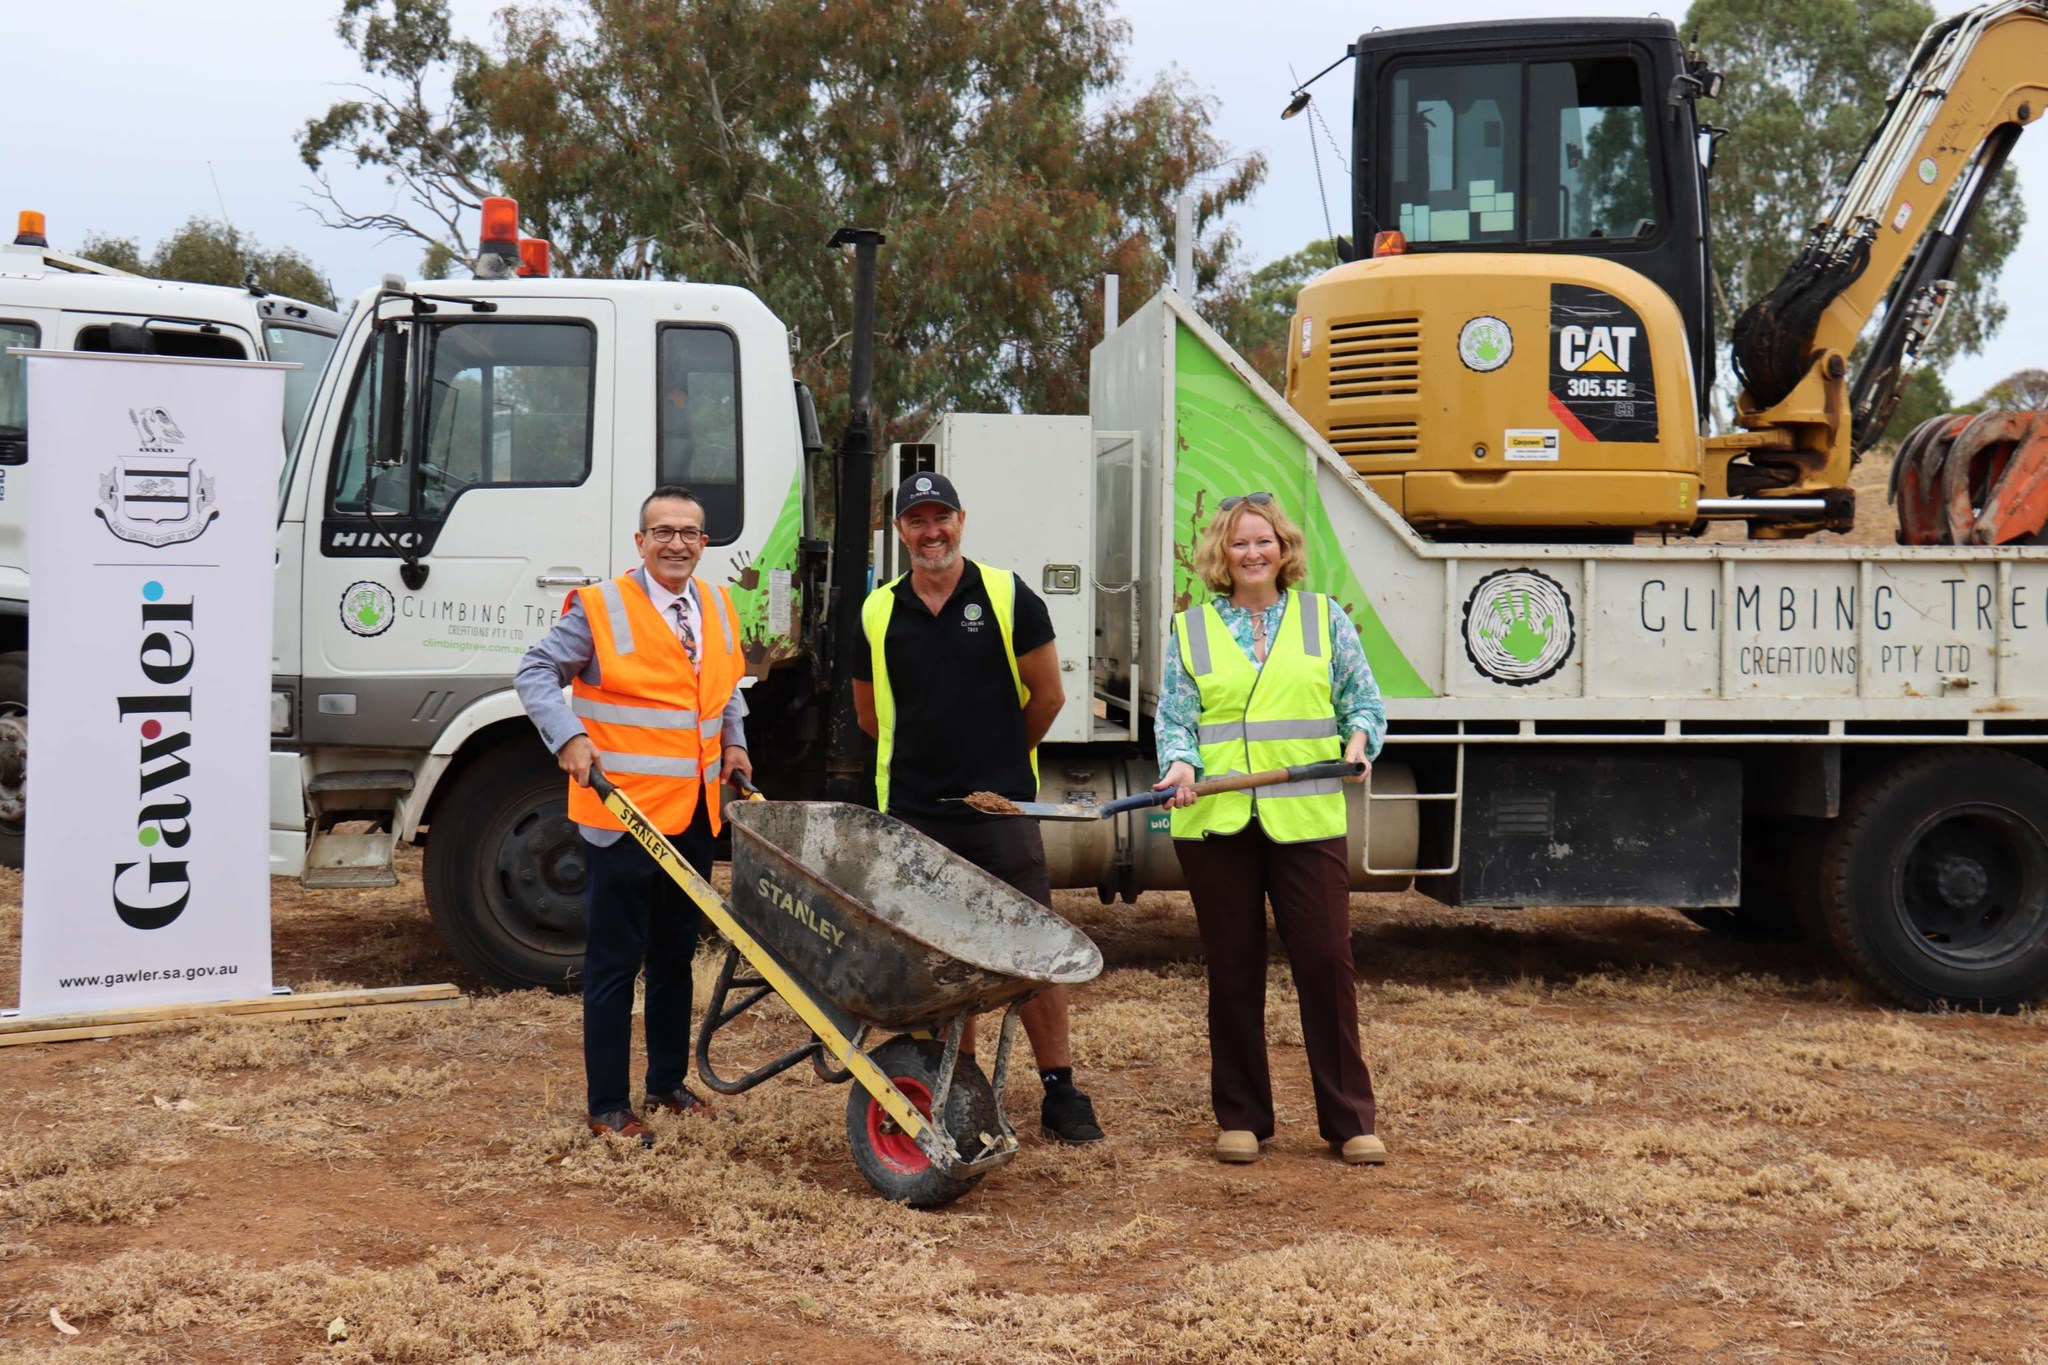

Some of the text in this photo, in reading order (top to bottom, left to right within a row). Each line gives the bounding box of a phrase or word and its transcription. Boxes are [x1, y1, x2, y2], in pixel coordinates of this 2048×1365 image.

[1560, 325, 1637, 373] CAT
[1614, 401, 1635, 418] CR
[111, 520, 127, 537] SANS
[156, 533, 176, 543] POINT
[177, 532, 188, 540] DE
[188, 521, 205, 537] FRUIT
[331, 532, 424, 548] HINO
[402, 595, 507, 625] CLIMBING
[1641, 579, 2048, 632] CLIMBING TRE
[422, 637, 527, 655] climbingtree.com.au
[448, 624, 525, 641] CREATIONS PTY LTD
[1740, 645, 1972, 675] CREATIONS PTY LTD
[113, 581, 196, 931] Gawler
[620, 808, 671, 862] STANLEY
[757, 877, 847, 948] STANLEY
[58, 963, 239, 989] www.gawler.sa.gov.au
